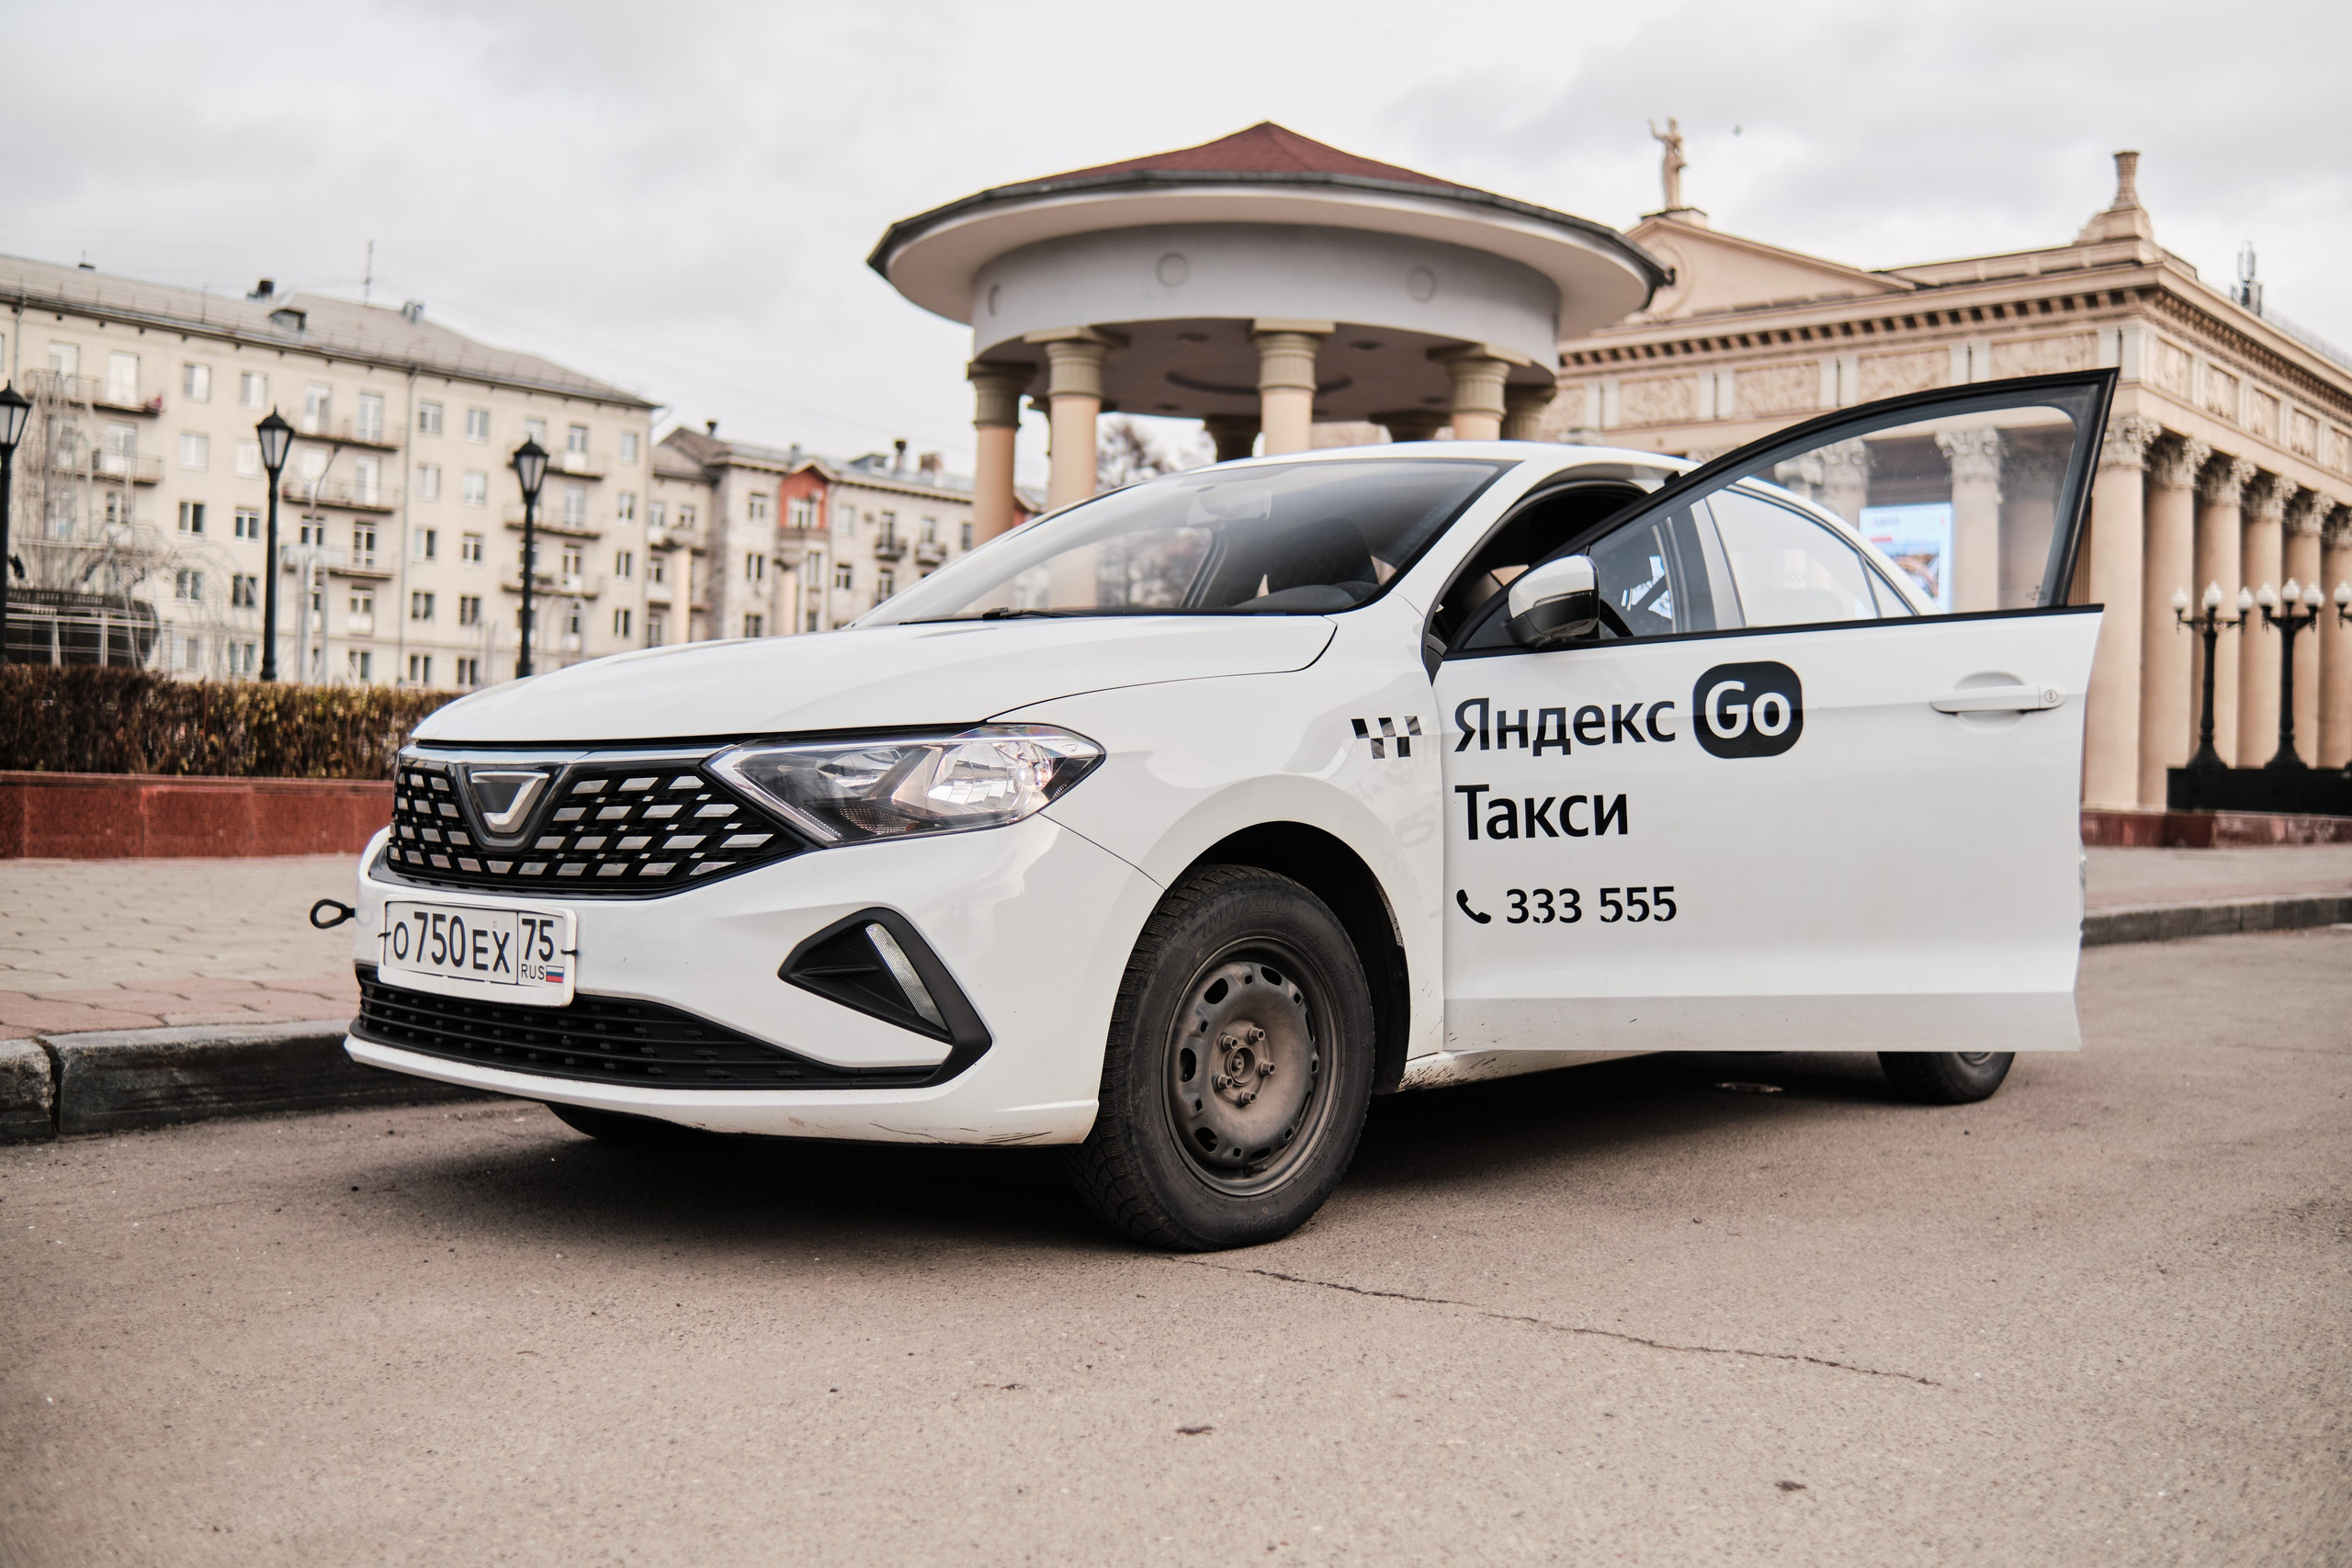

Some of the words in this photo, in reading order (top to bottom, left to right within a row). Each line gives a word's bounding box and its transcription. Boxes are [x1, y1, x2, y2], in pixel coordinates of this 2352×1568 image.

[1454, 697, 1676, 757] Яндекс
[1704, 681, 1791, 739] Go
[1454, 784, 1628, 840] Такси
[1506, 887, 1582, 924] 333
[1600, 886, 1678, 923] 555
[521, 918, 555, 962] 75
[521, 963, 545, 980] RUS
